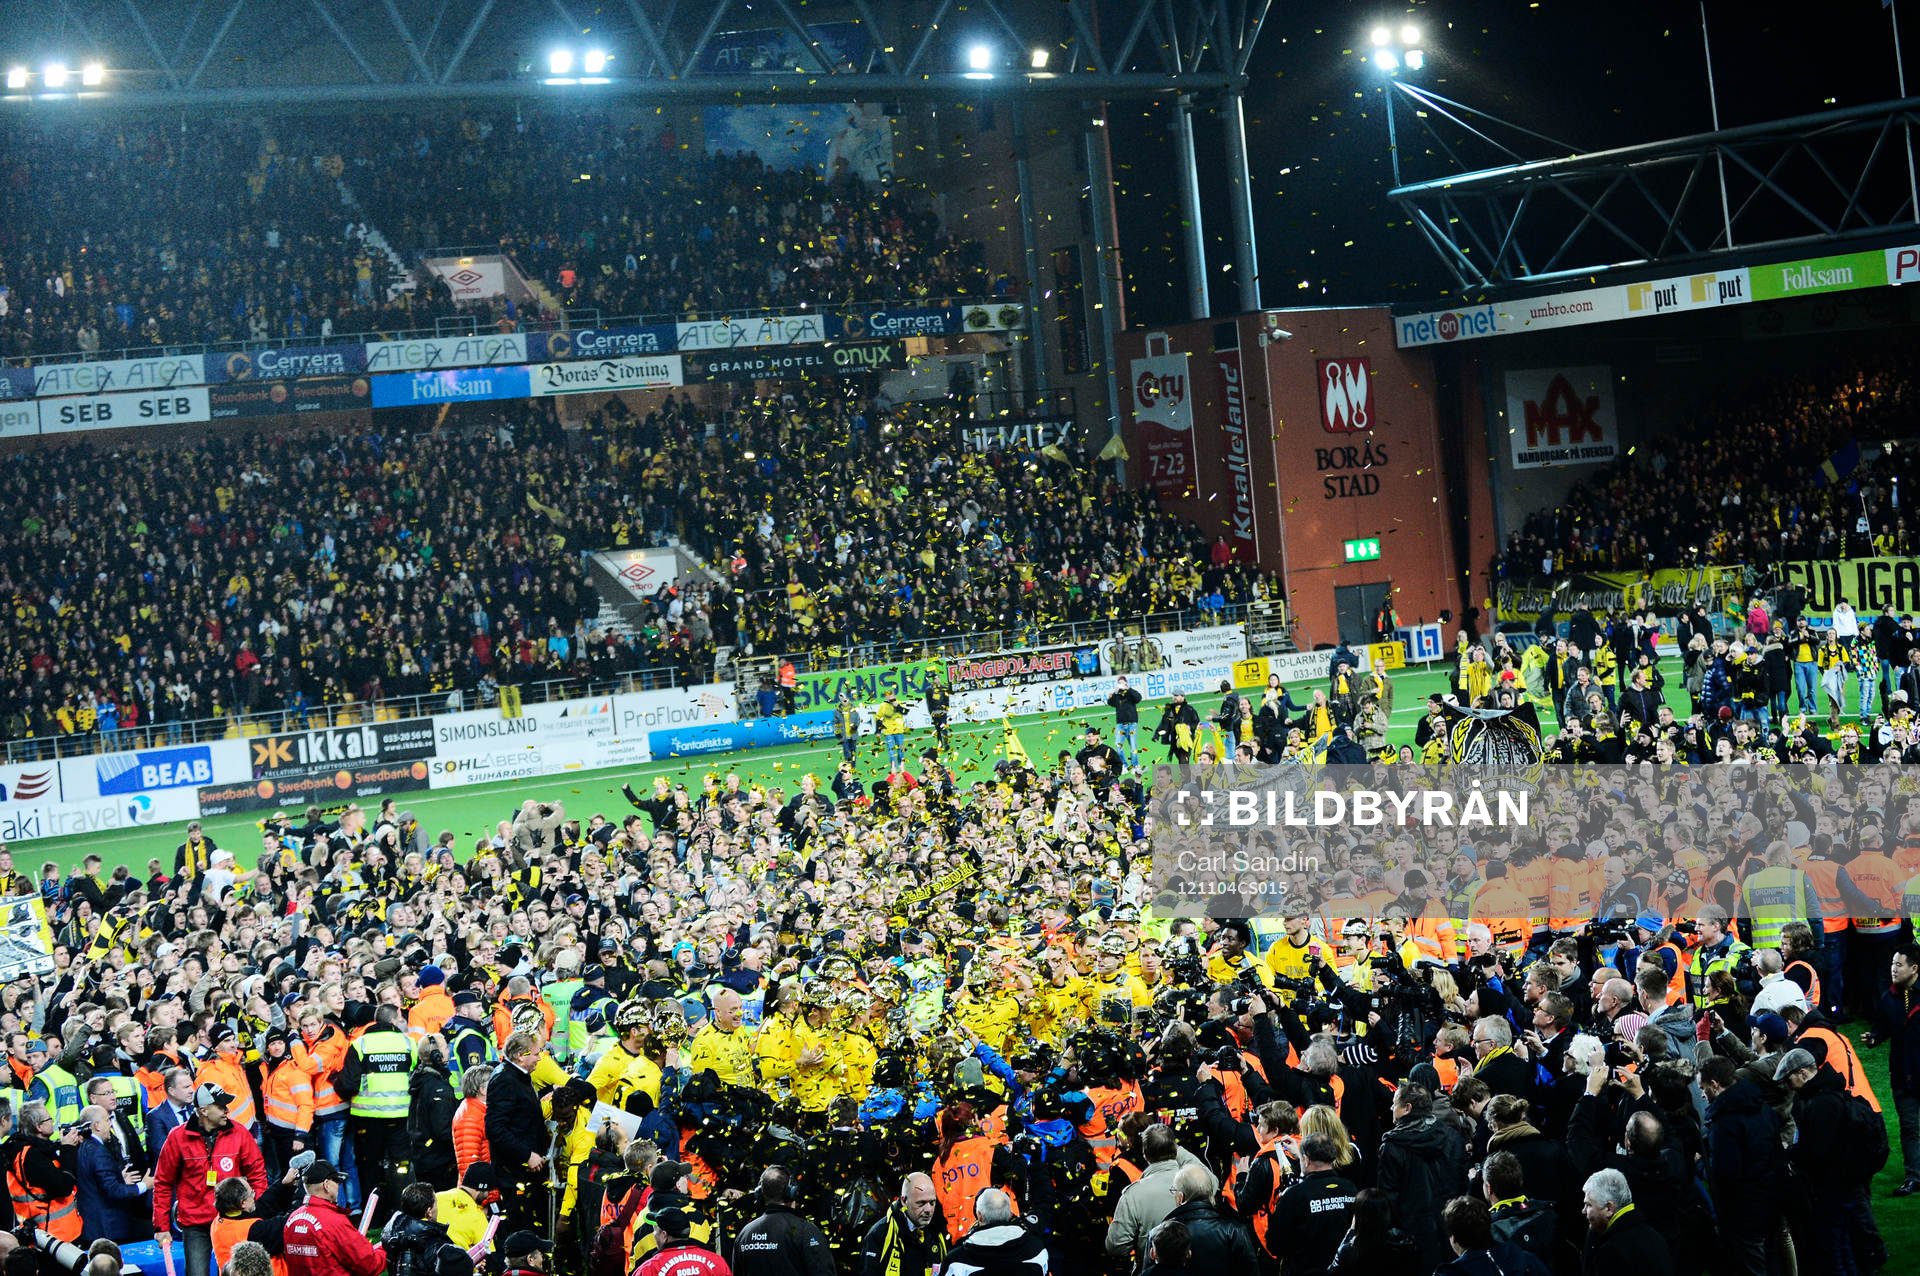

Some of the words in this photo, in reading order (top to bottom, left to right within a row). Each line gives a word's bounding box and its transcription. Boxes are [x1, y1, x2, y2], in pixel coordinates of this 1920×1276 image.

[1782, 265, 1853, 292] Folksam
[870, 312, 943, 331] Cernera
[1530, 299, 1594, 321] umbro.com
[576, 330, 658, 350] Cernera
[681, 320, 748, 348] ATEA
[756, 318, 819, 346] ATEA
[369, 344, 441, 370] ATEA
[453, 338, 522, 365] ATEA
[709, 359, 765, 373] GRAND
[772, 355, 824, 369] HOTEL
[833, 345, 893, 370] onyx
[37, 364, 111, 394] ATEA
[126, 358, 200, 388] ATEA
[542, 364, 600, 388] Borås
[600, 360, 670, 382] Tidning
[411, 375, 493, 401] Folksam
[1137, 370, 1184, 408] City
[60, 403, 113, 424] SEB
[139, 397, 192, 418] SEB
[1524, 372, 1604, 448] MAX
[1220, 363, 1253, 540] Knalleland
[1315, 438, 1389, 471] BORÅS
[1581, 445, 1615, 459] SVENSKA
[1150, 452, 1186, 477] 7-23
[1324, 475, 1380, 499] STAD
[1274, 654, 1318, 669] TD-LARM
[1379, 645, 1395, 657] TD
[948, 651, 1073, 683] FÄRGBOLAGET
[1168, 671, 1181, 683] AB
[1182, 666, 1230, 681] BOSTÄDER
[1293, 668, 1323, 680] 033-10
[624, 706, 701, 730] ProFlow
[439, 717, 537, 744] SIMONSLAND
[783, 723, 833, 740] Fantastiskt.s
[297, 726, 379, 765] ikkab
[675, 737, 732, 752] Fantastiskt.se
[142, 759, 211, 789] BEAB
[277, 777, 335, 793] Swedbank
[354, 767, 411, 784] Swedbank
[199, 787, 257, 802] Swedbank
[48, 798, 122, 835] travel
[369, 1053, 406, 1063] ORDNINGS
[378, 1064, 399, 1072] VAKT
[1175, 1107, 1197, 1117] TAPE
[942, 1163, 979, 1184] FOTO
[1326, 1203, 1345, 1211] BORÅS
[751, 1232, 768, 1241] Host
[657, 1251, 706, 1276] BRANDKÅRENS
[676, 1265, 700, 1276] BORÅS
